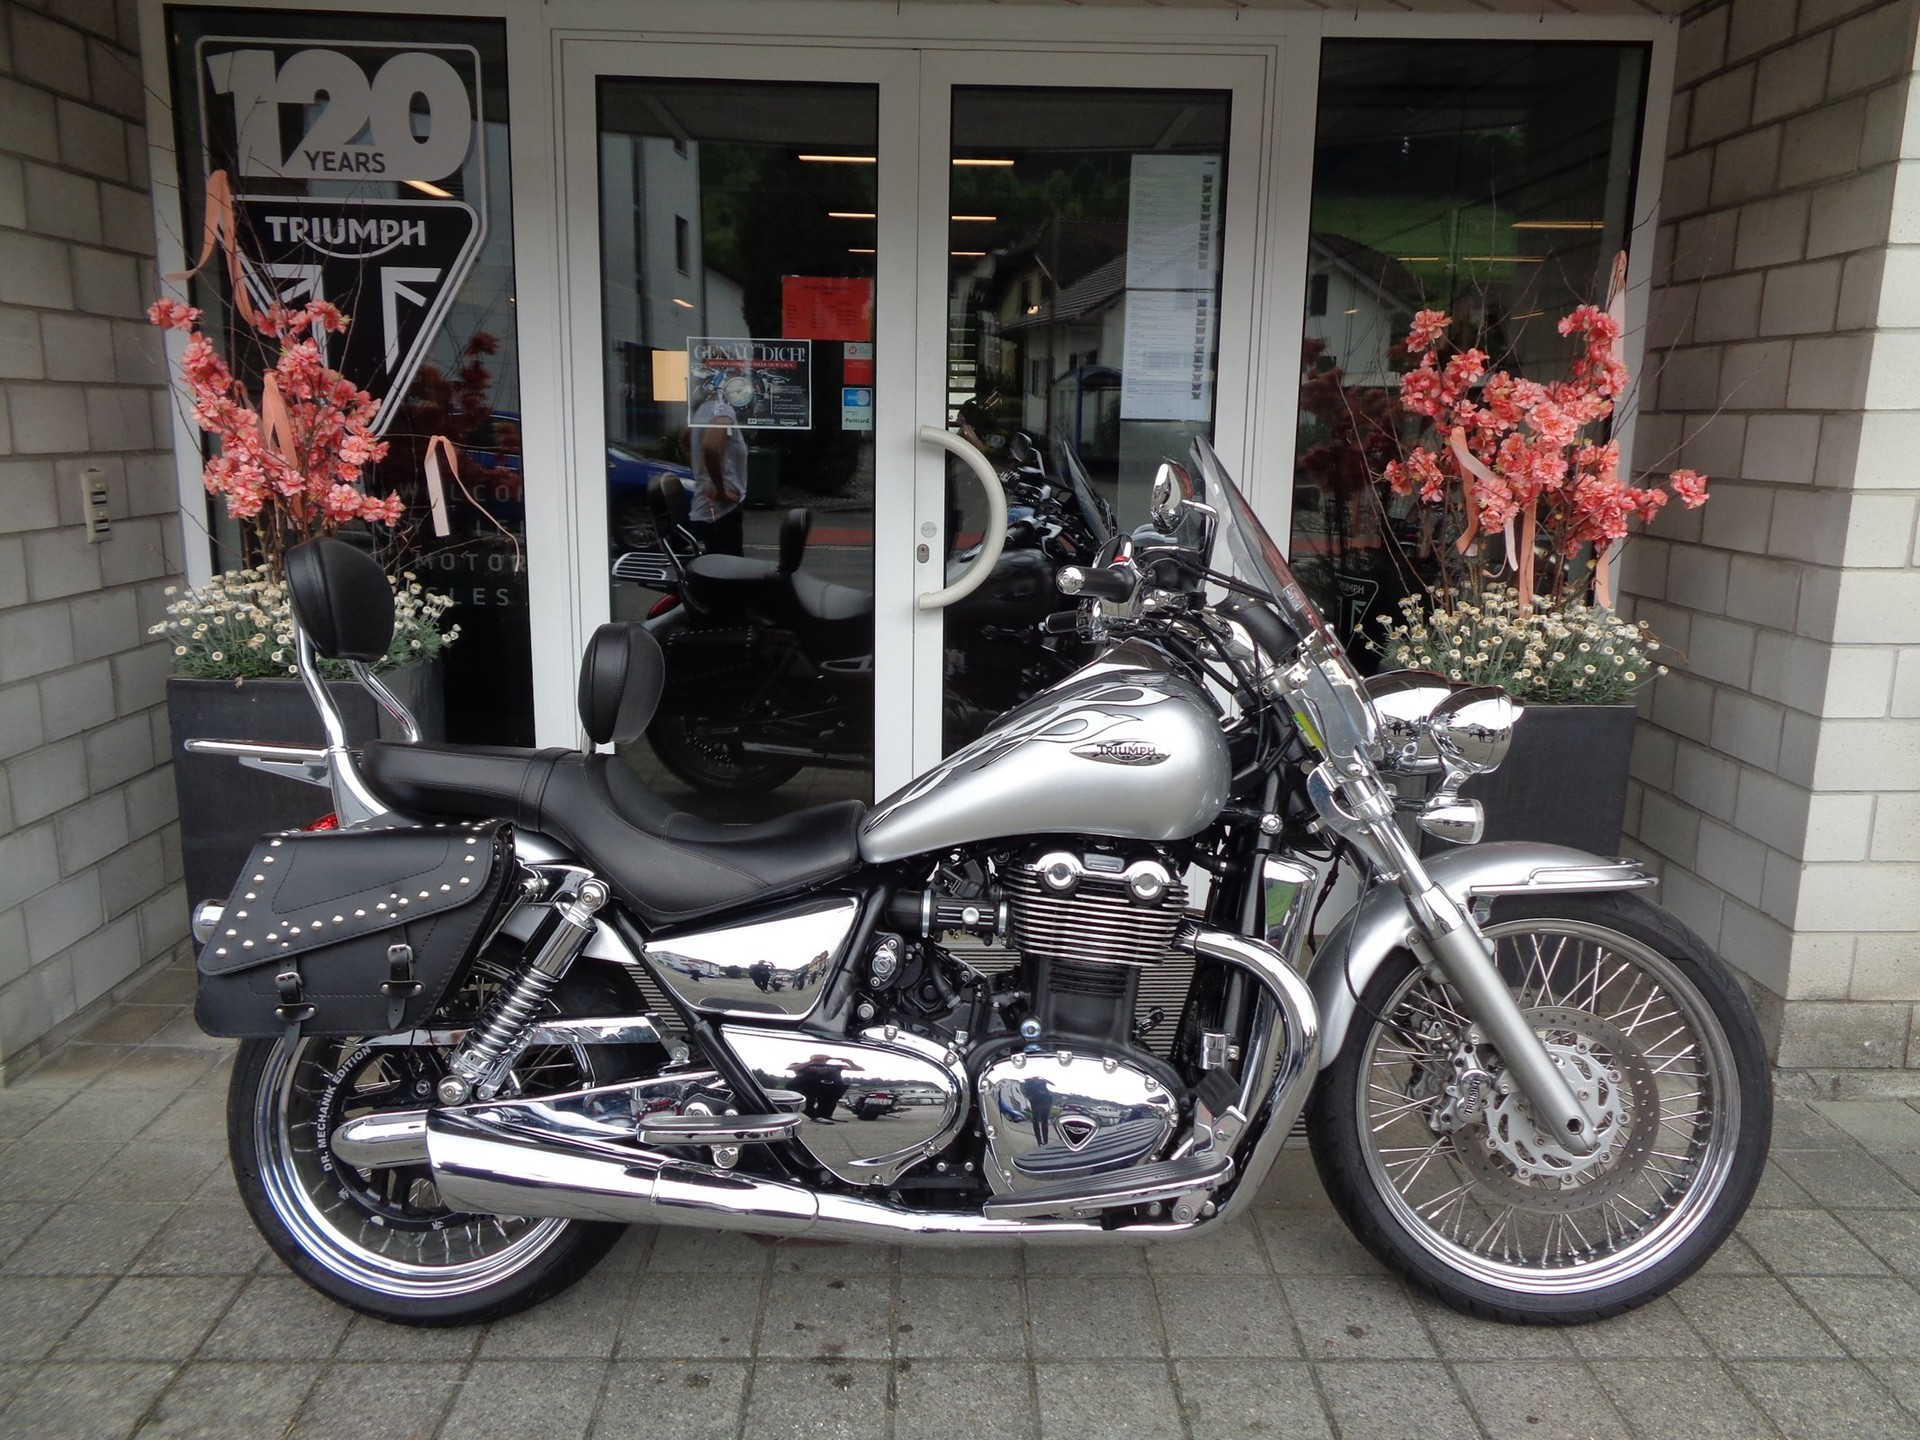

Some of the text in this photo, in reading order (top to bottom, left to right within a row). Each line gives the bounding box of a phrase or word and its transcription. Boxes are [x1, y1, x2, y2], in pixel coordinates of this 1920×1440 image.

[206, 49, 472, 182] 120
[304, 150, 386, 174] YEARS
[265, 215, 427, 253] TRIUMPH
[761, 346, 806, 362] DICH!
[415, 553, 526, 572] MOTOR
[1096, 743, 1157, 759] TRIUMPH
[316, 1045, 372, 1172] DR. MECHANIK EDITION
[1464, 1080, 1480, 1116] TRIUMPH
